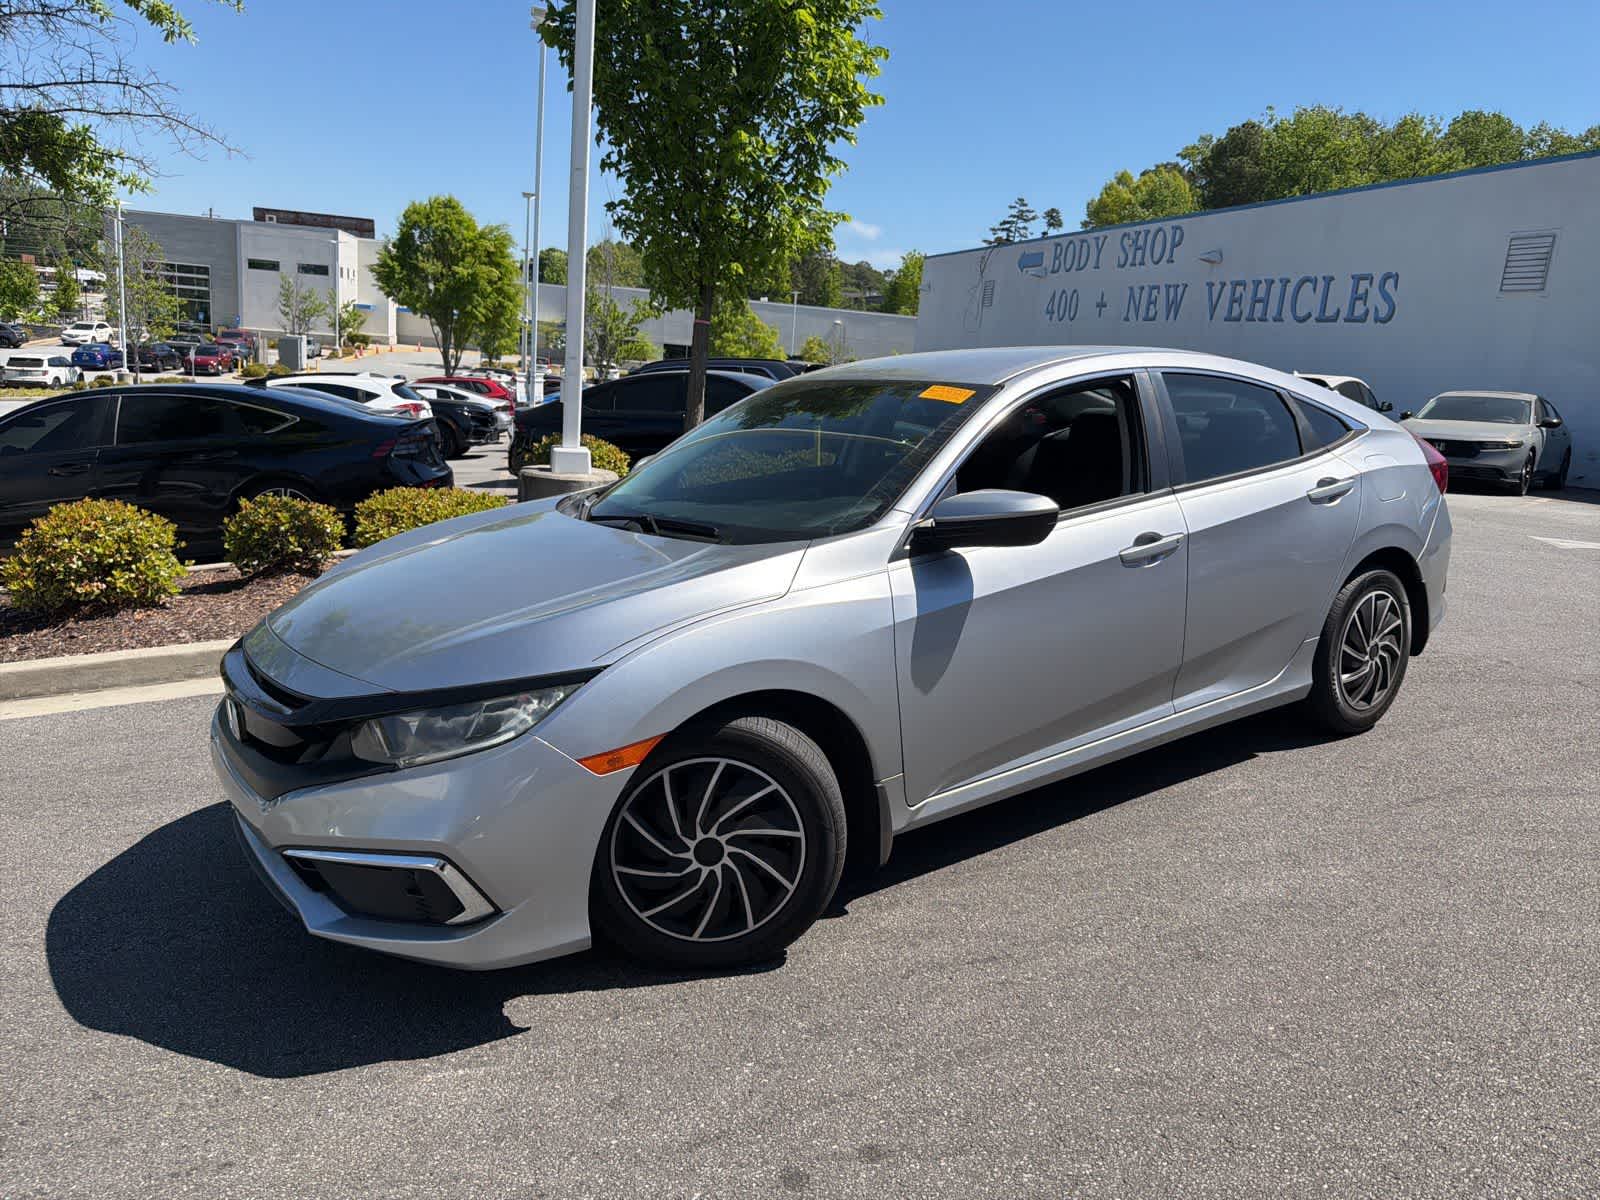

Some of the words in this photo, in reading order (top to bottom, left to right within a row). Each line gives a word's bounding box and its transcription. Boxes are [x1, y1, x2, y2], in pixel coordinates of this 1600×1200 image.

[1050, 235, 1108, 274] BODY
[1116, 225, 1185, 269] SHOP
[1045, 289, 1079, 322] 400
[1095, 290, 1108, 319] +
[1123, 283, 1189, 321] NEW
[1206, 271, 1400, 324] VEHICLES
